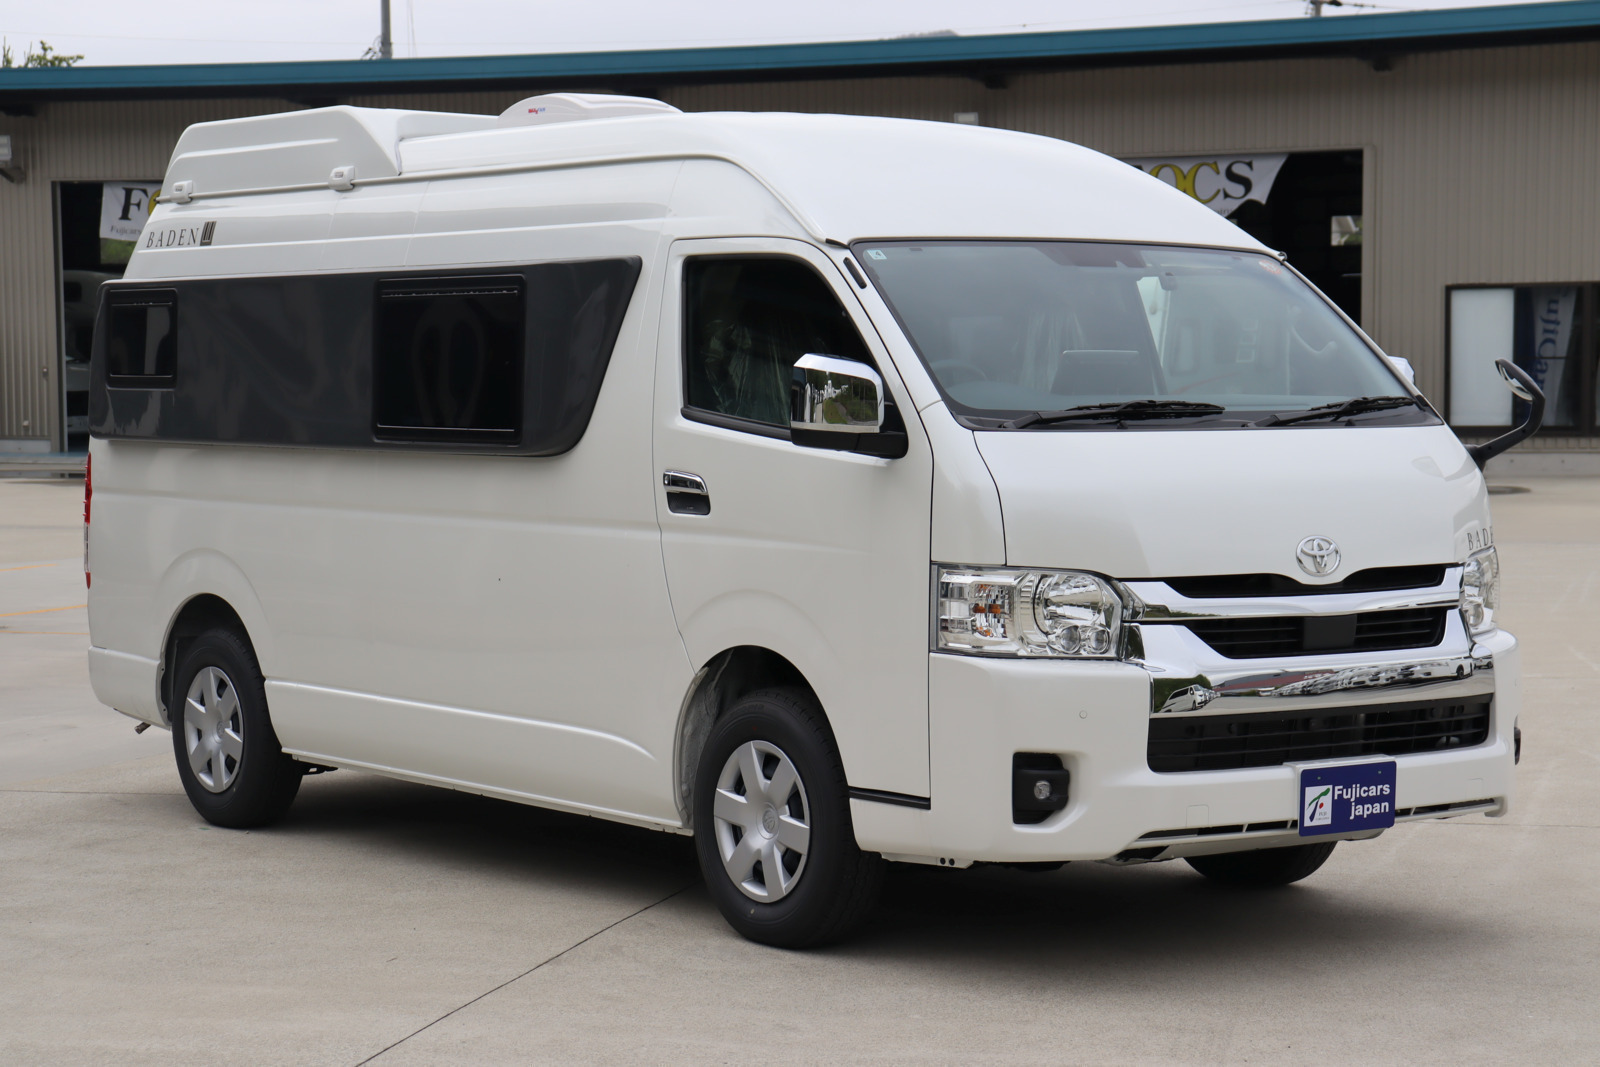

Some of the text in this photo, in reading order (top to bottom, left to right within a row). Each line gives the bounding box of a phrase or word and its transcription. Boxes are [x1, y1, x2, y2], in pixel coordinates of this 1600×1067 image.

[1132, 160, 1253, 204] OCS
[146, 227, 200, 248] BADEN
[1334, 783, 1391, 802] Fujicars
[1349, 801, 1389, 820] japan
